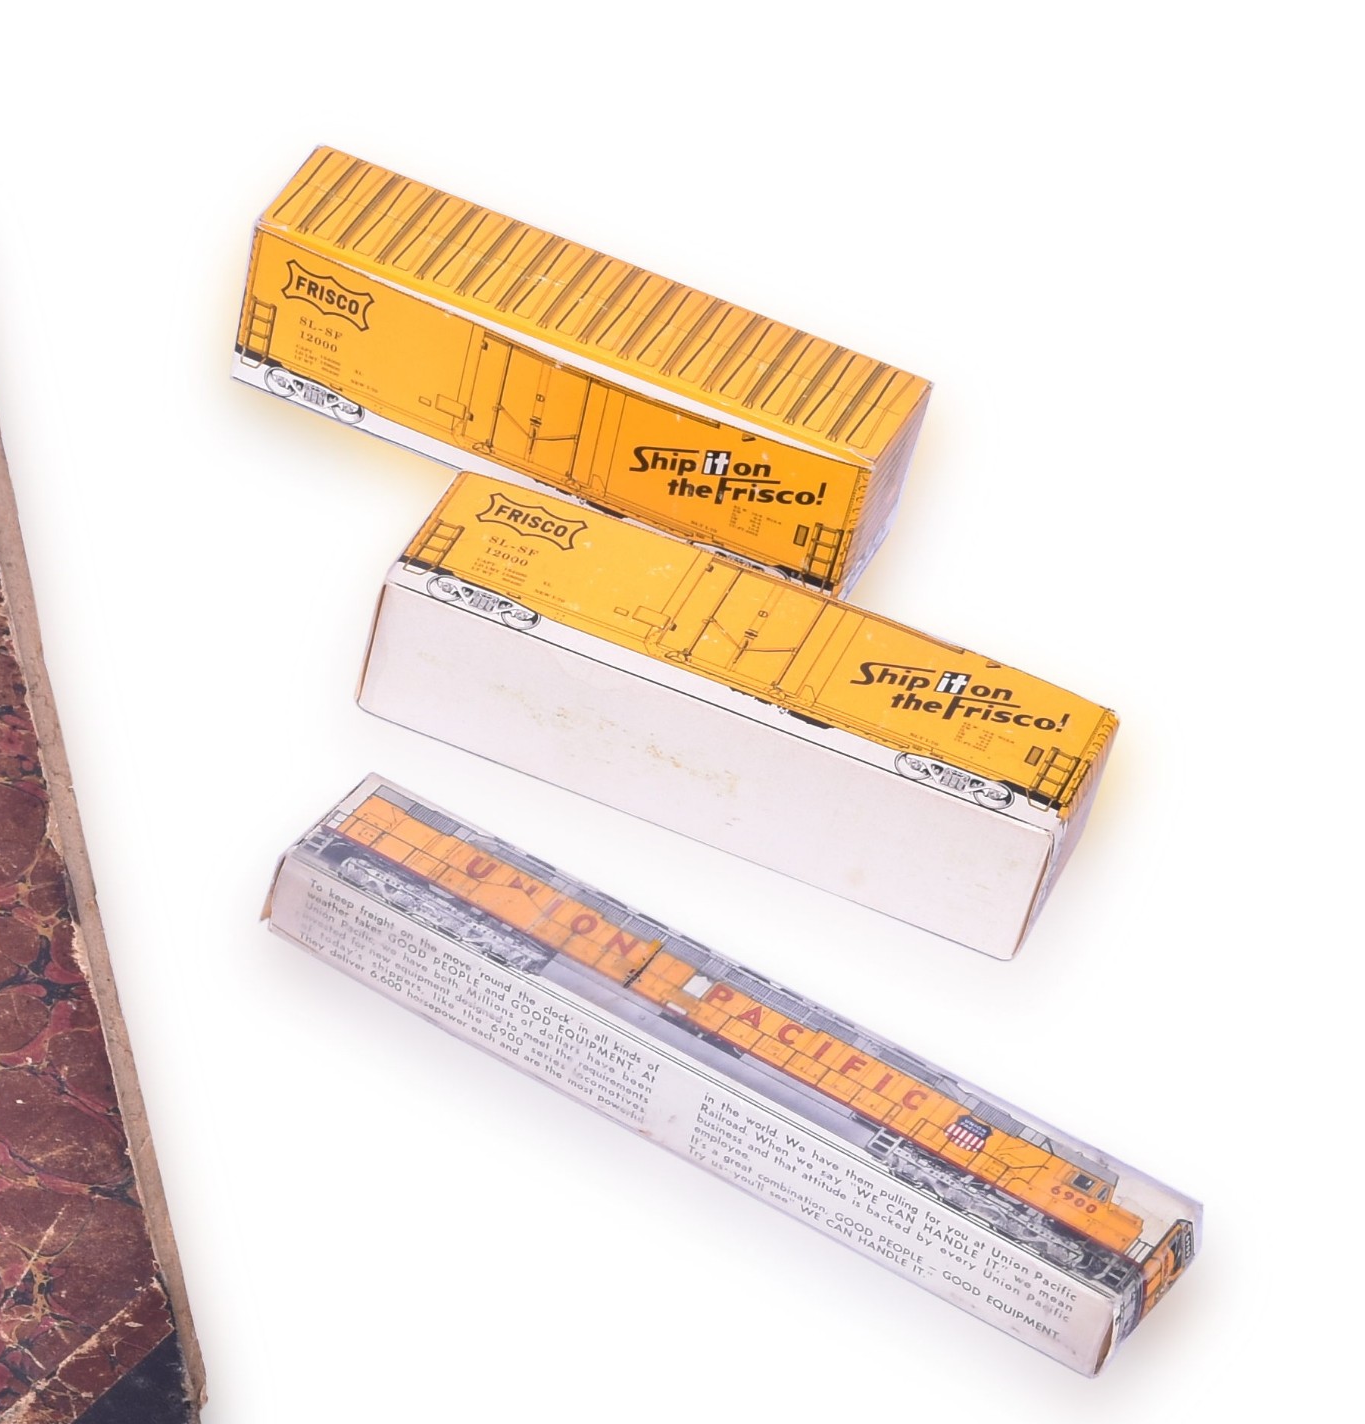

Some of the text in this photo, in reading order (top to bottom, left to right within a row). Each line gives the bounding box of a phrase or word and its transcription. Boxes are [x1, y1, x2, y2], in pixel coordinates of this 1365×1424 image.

[296, 275, 359, 315] FRISCO
[299, 316, 343, 341] SL-SF
[299, 331, 338, 353] 12000
[629, 446, 771, 477] Ship it on
[667, 477, 827, 505] the Frisco!
[494, 504, 568, 538] FRISCO
[485, 547, 529, 567] 12000
[489, 535, 540, 557] SL-SF
[850, 661, 1014, 702] Ship it on
[890, 693, 1071, 732] the Frisco!
[466, 856, 931, 1111] UNION PACIFIC
[386, 932, 427, 959] GOOD
[431, 955, 480, 988] PEOPLE
[483, 986, 506, 1002] and
[509, 998, 551, 1026] GOOD
[556, 1023, 635, 1073] EQUIPMENT.
[640, 1070, 656, 1084] At
[1050, 1184, 1098, 1215] 6900
